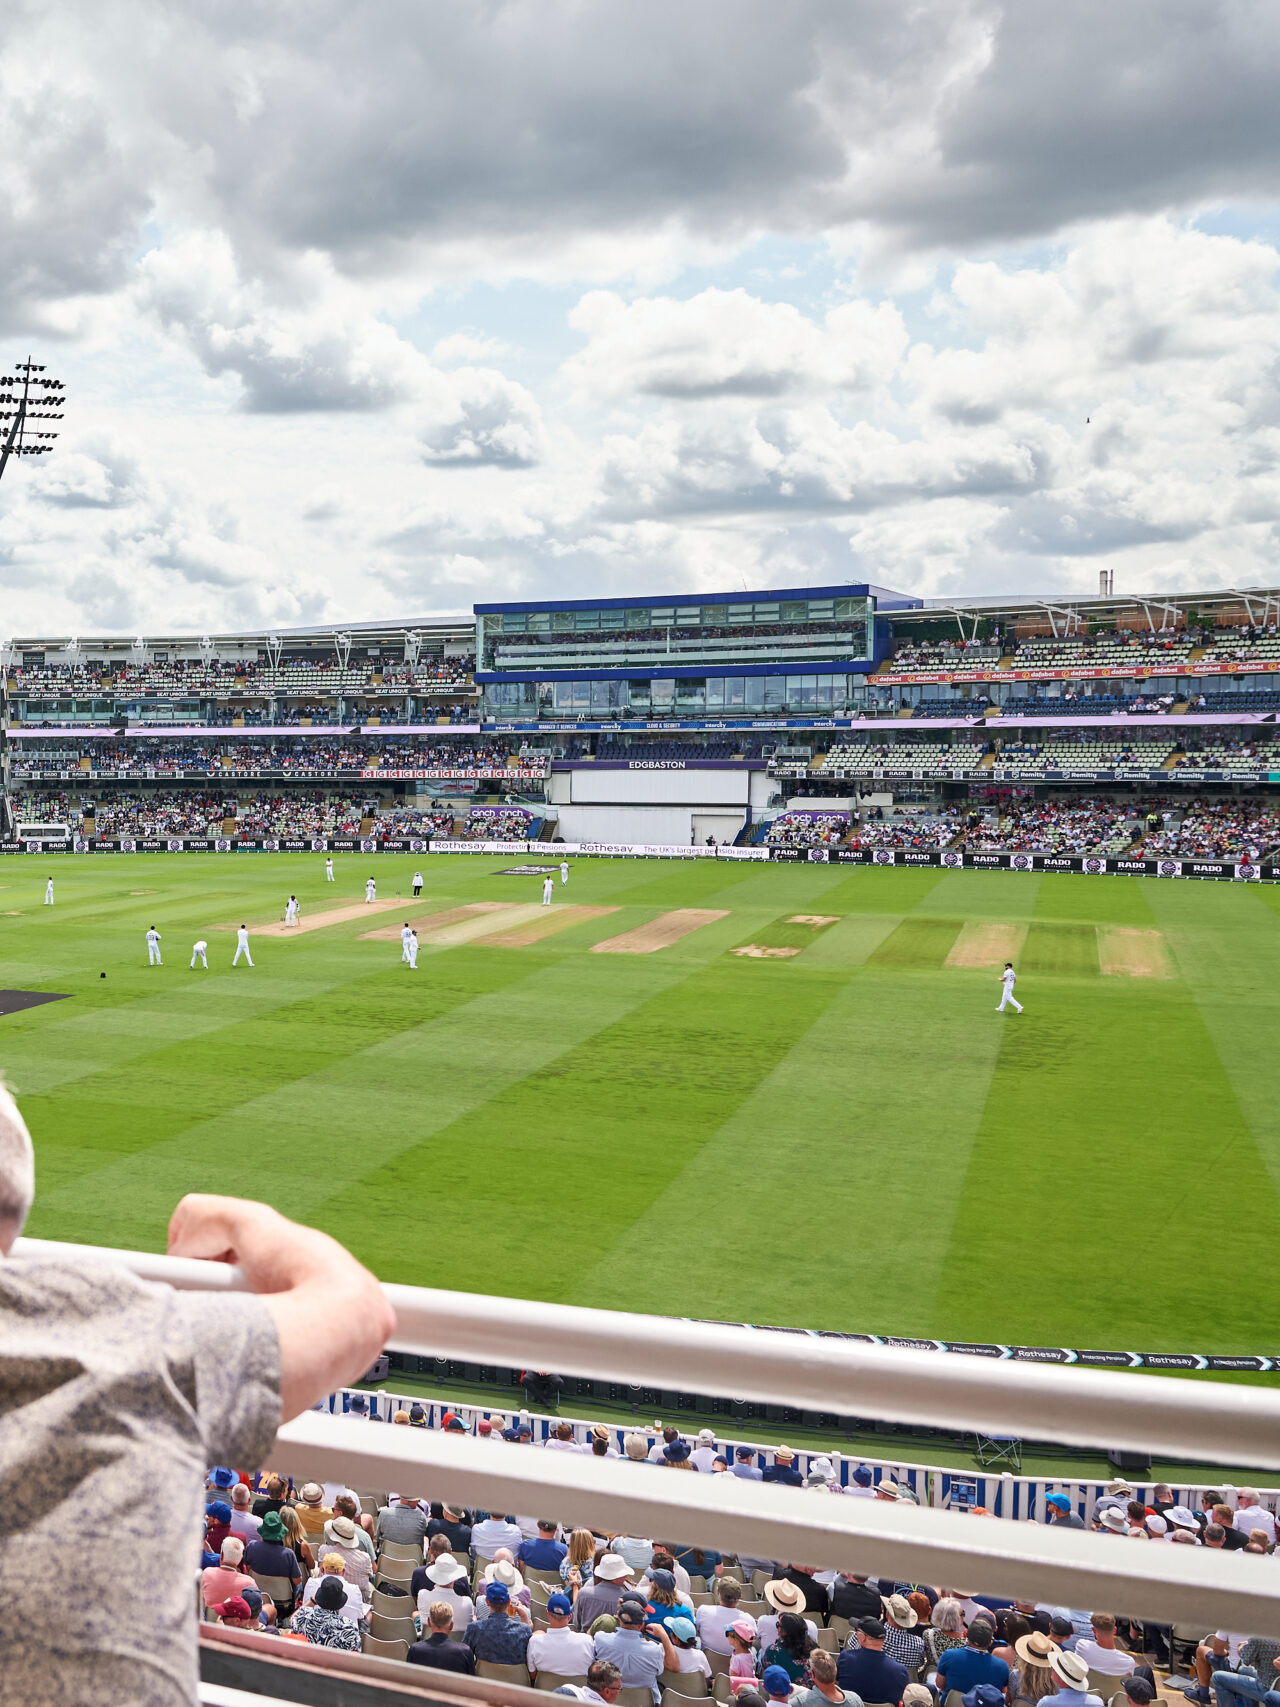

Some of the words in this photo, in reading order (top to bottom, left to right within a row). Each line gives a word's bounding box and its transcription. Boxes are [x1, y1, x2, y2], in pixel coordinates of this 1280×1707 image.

[1111, 668, 1136, 676] dafabet
[629, 761, 686, 769] EDGBASTON
[1177, 772, 1204, 780] Remitly
[472, 809, 495, 817] cinch
[499, 809, 523, 817] cinch
[434, 842, 486, 850] Rothesay
[579, 844, 633, 853] Rothesay
[677, 847, 703, 855] largest
[888, 1340, 931, 1350] Rothesay
[1018, 1350, 1061, 1359] Rothesay
[1149, 1356, 1192, 1366] Rothesay
